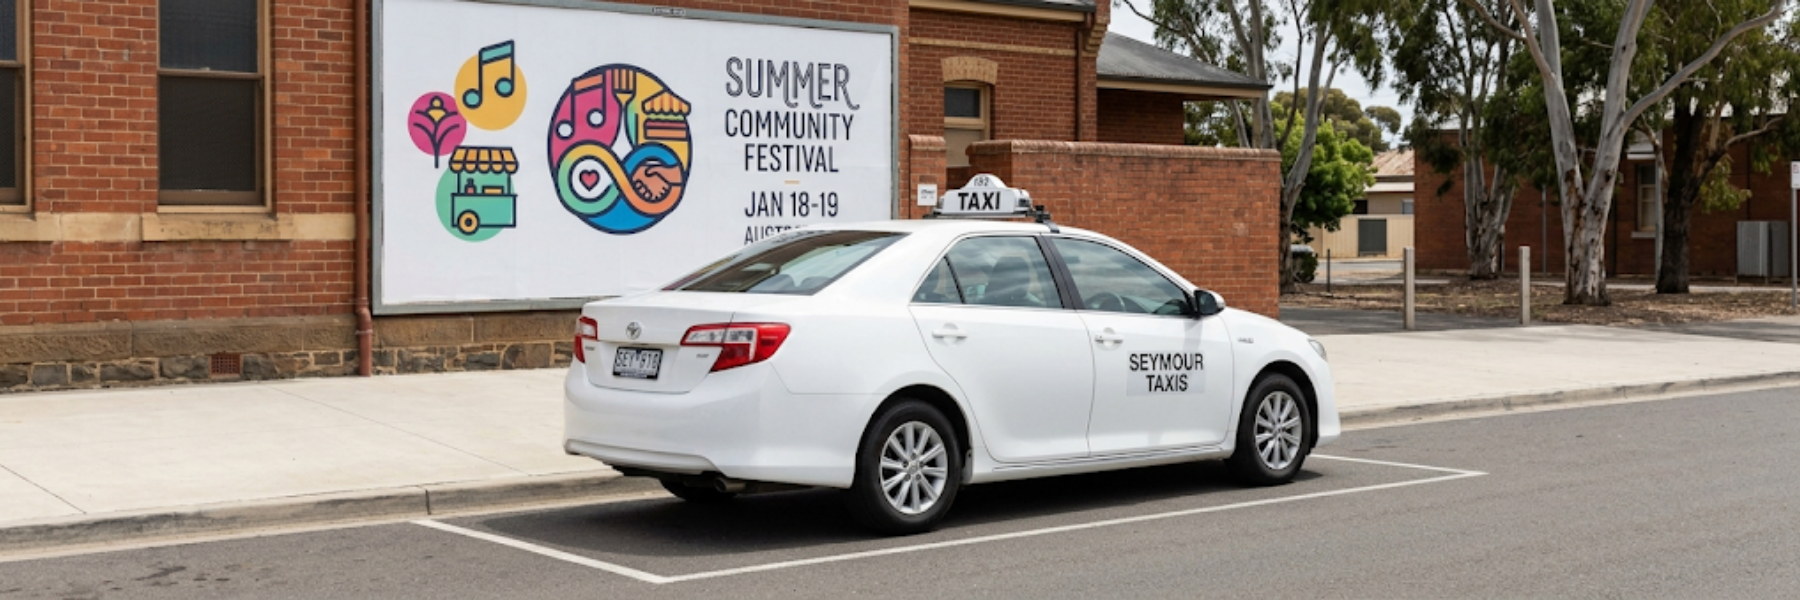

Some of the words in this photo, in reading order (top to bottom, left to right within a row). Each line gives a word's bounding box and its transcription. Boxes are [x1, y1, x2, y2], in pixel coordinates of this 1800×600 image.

[726, 56, 860, 110] SUMMER
[724, 108, 854, 140] COMMUNITY
[744, 143, 839, 173] FESTIVAL
[744, 191, 783, 217] JAN
[790, 191, 839, 217] 18-19
[958, 192, 1001, 210] TAXI
[1129, 353, 1204, 371] SEYMOUR
[1146, 374, 1189, 392] TAXIS
